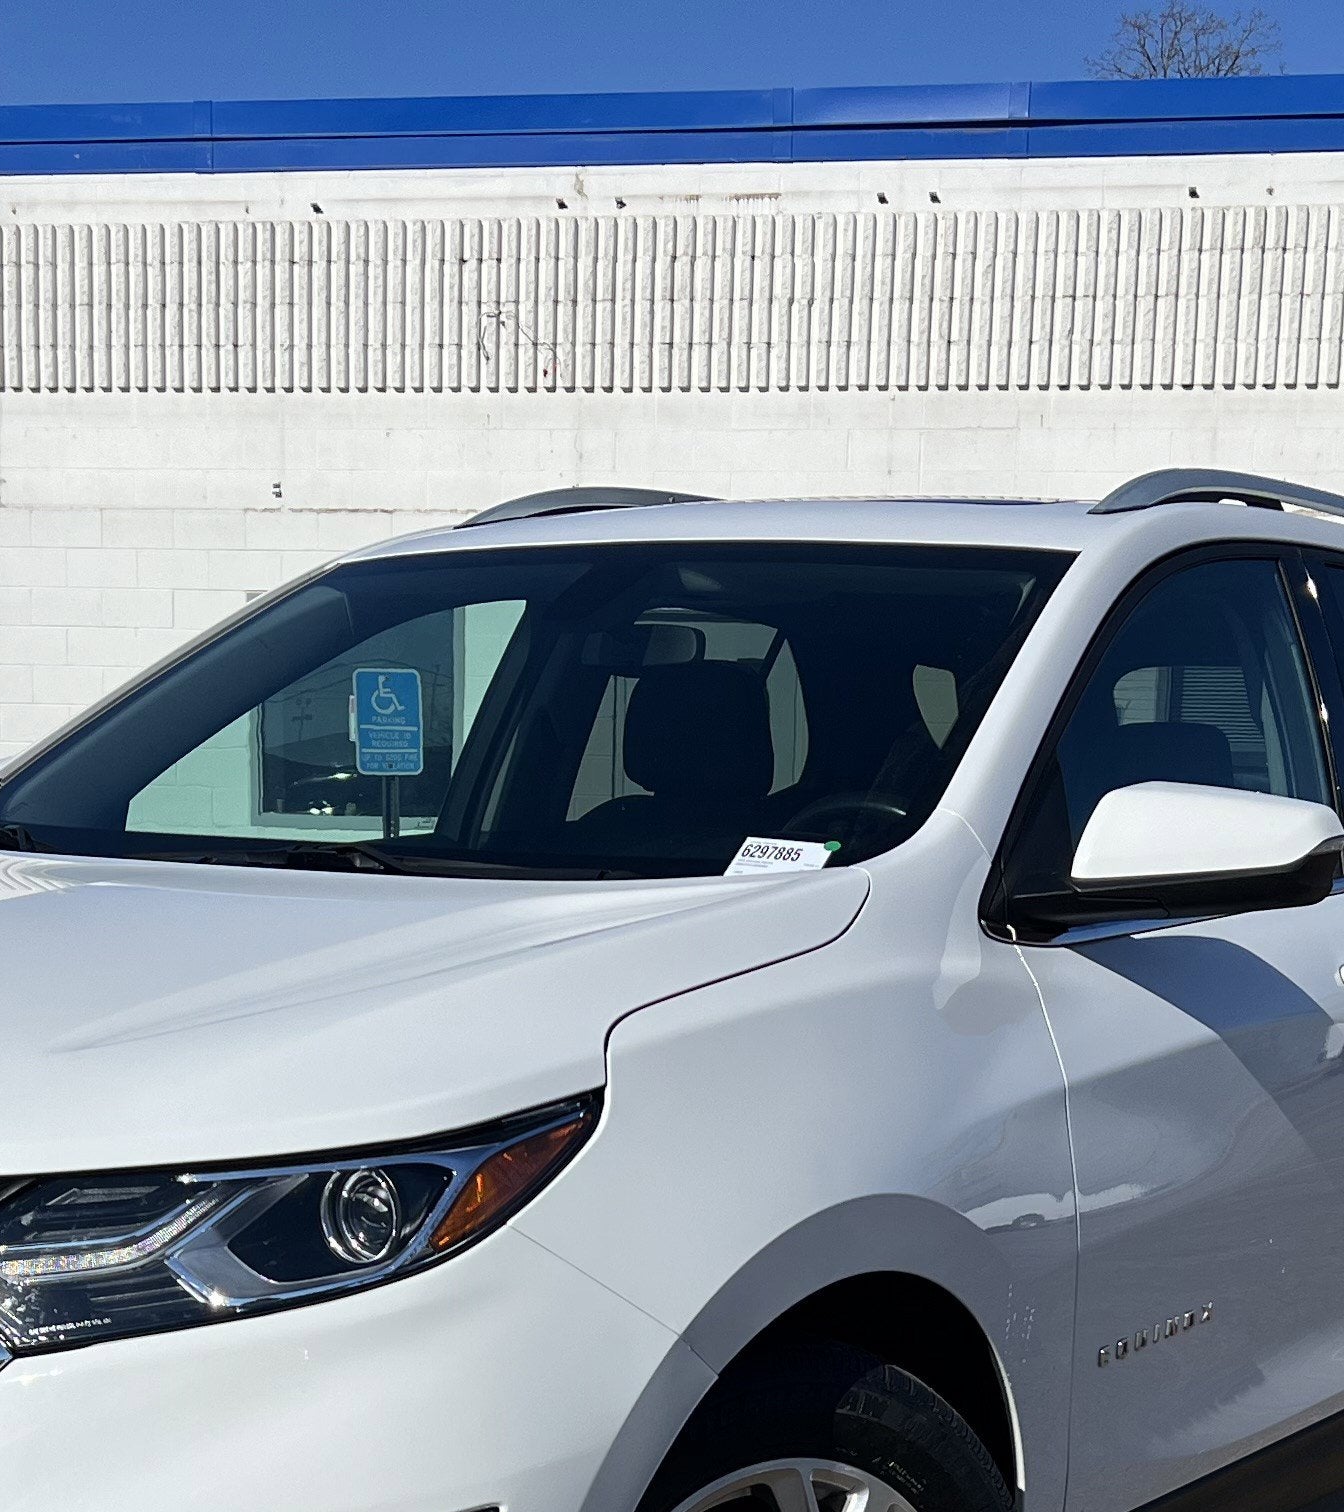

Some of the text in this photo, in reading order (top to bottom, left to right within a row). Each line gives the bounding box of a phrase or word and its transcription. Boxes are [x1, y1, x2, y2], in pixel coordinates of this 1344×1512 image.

[371, 716, 406, 724] PARKING
[741, 843, 804, 862] 6297885
[1098, 1299, 1215, 1368] EQUINOX
